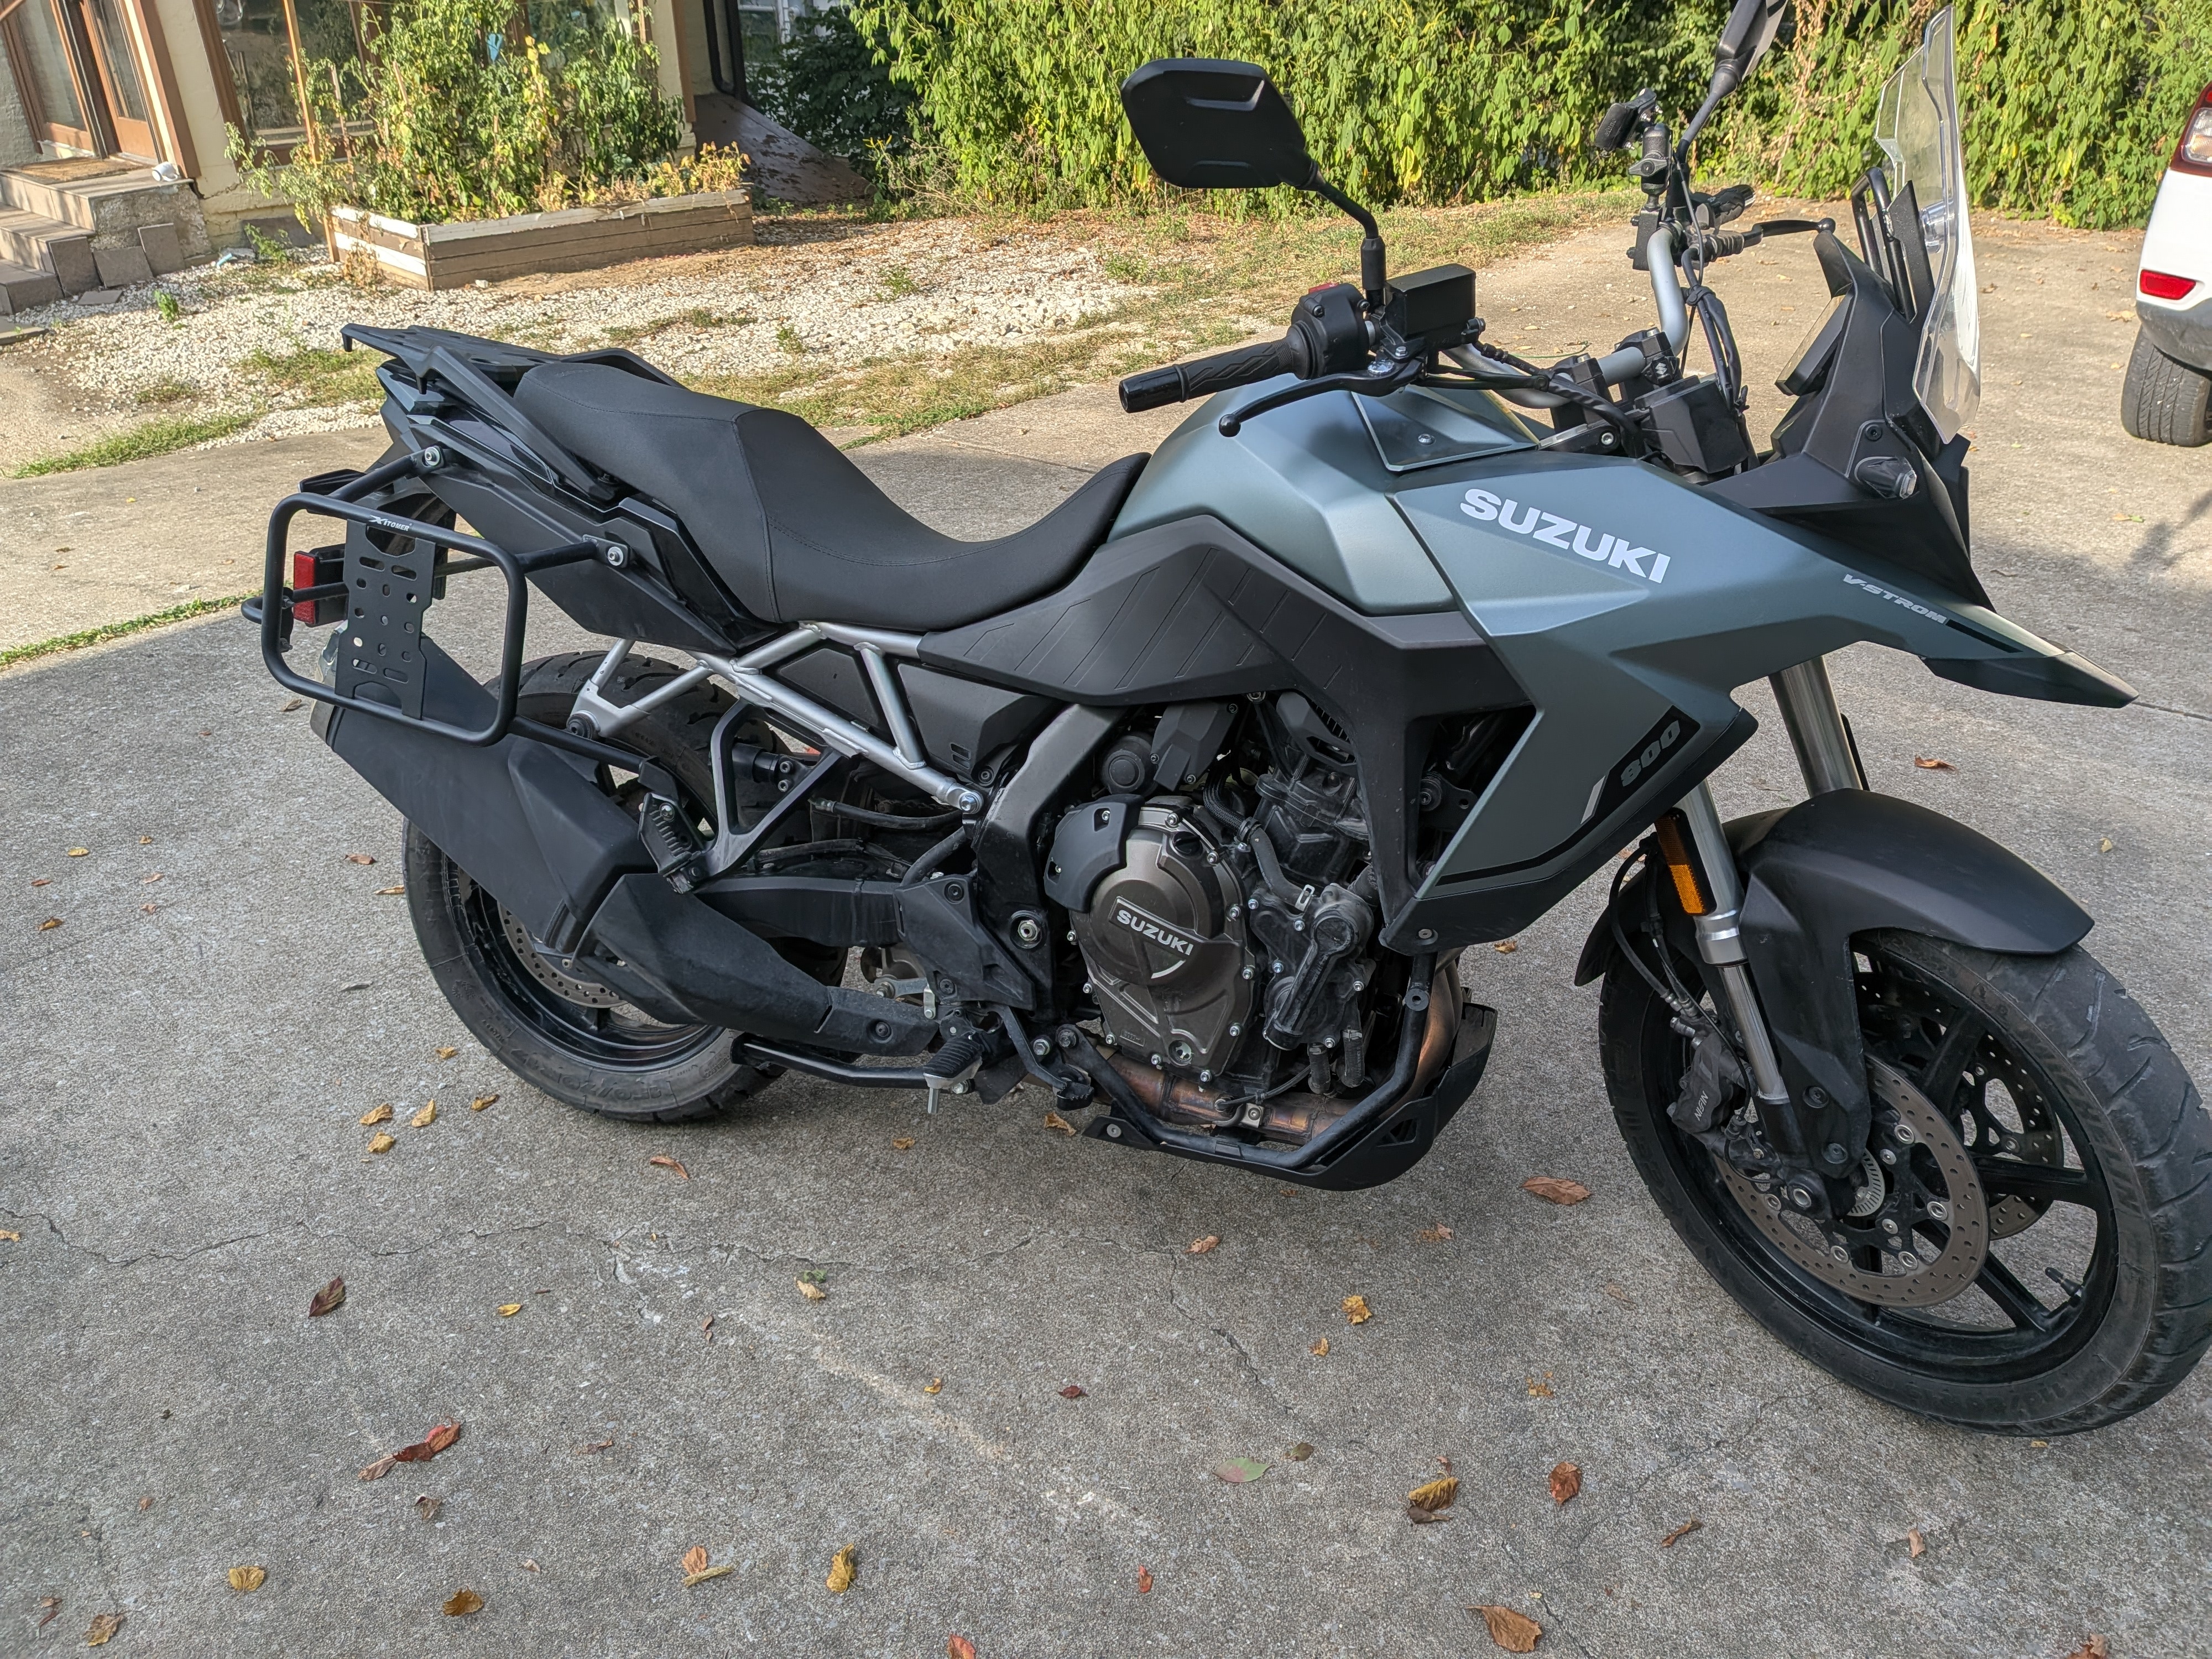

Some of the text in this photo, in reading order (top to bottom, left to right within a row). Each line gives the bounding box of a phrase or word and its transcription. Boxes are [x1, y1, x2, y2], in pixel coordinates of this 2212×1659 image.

[1460, 488, 1671, 583] SUZUKI
[1843, 573, 1947, 624] V-STROM
[1620, 720, 1681, 787] 800
[1117, 910, 1194, 956] SUZUKI
